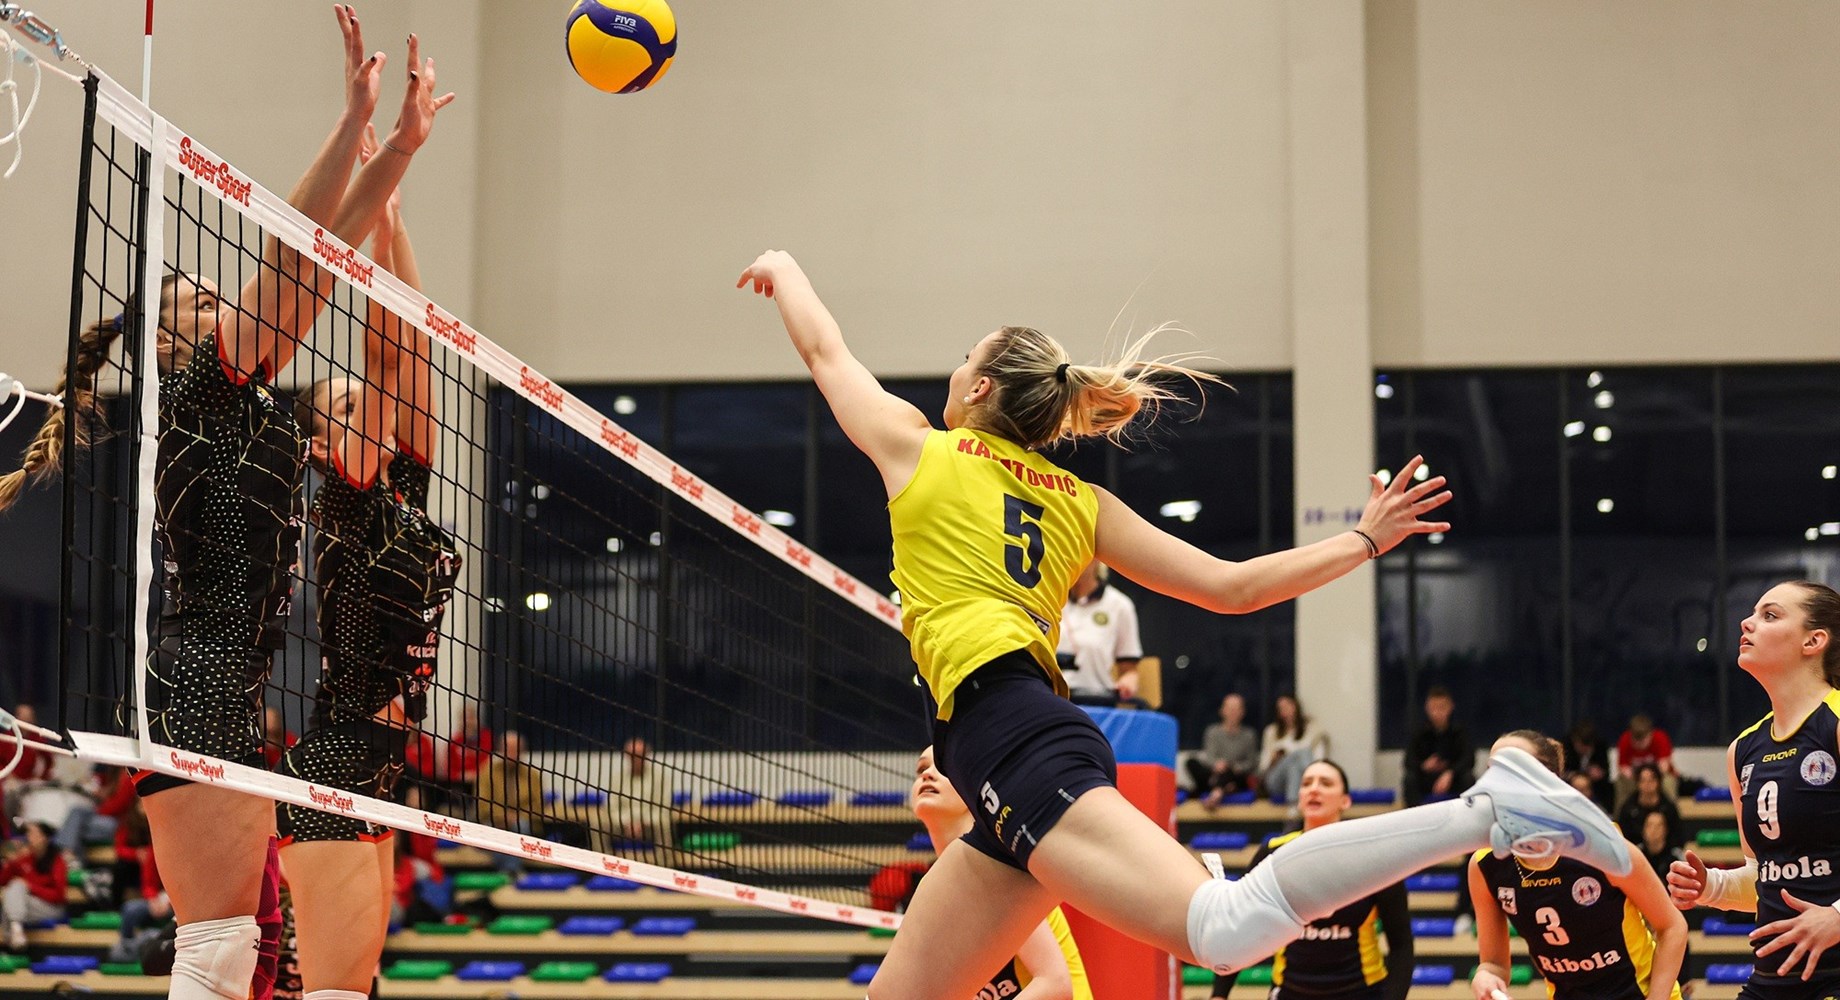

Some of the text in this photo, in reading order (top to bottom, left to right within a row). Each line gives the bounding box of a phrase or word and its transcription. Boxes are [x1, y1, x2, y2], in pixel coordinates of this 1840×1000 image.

[614, 14, 637, 27] FIVB
[178, 136, 252, 207] SuperSport
[313, 228, 374, 289] SuperSport
[424, 303, 477, 355] SuperSport
[520, 366, 564, 413] SuperSport
[1003, 492, 1045, 589] 5
[170, 751, 226, 782] SuperSport
[1761, 747, 1797, 763] GIVOVA
[308, 785, 356, 813] SuperSport
[1757, 780, 1780, 840] 9
[1760, 855, 1832, 883] ibola
[1300, 924, 1352, 940] bola
[1535, 906, 1570, 946] 3
[1537, 949, 1621, 973] Ribola
